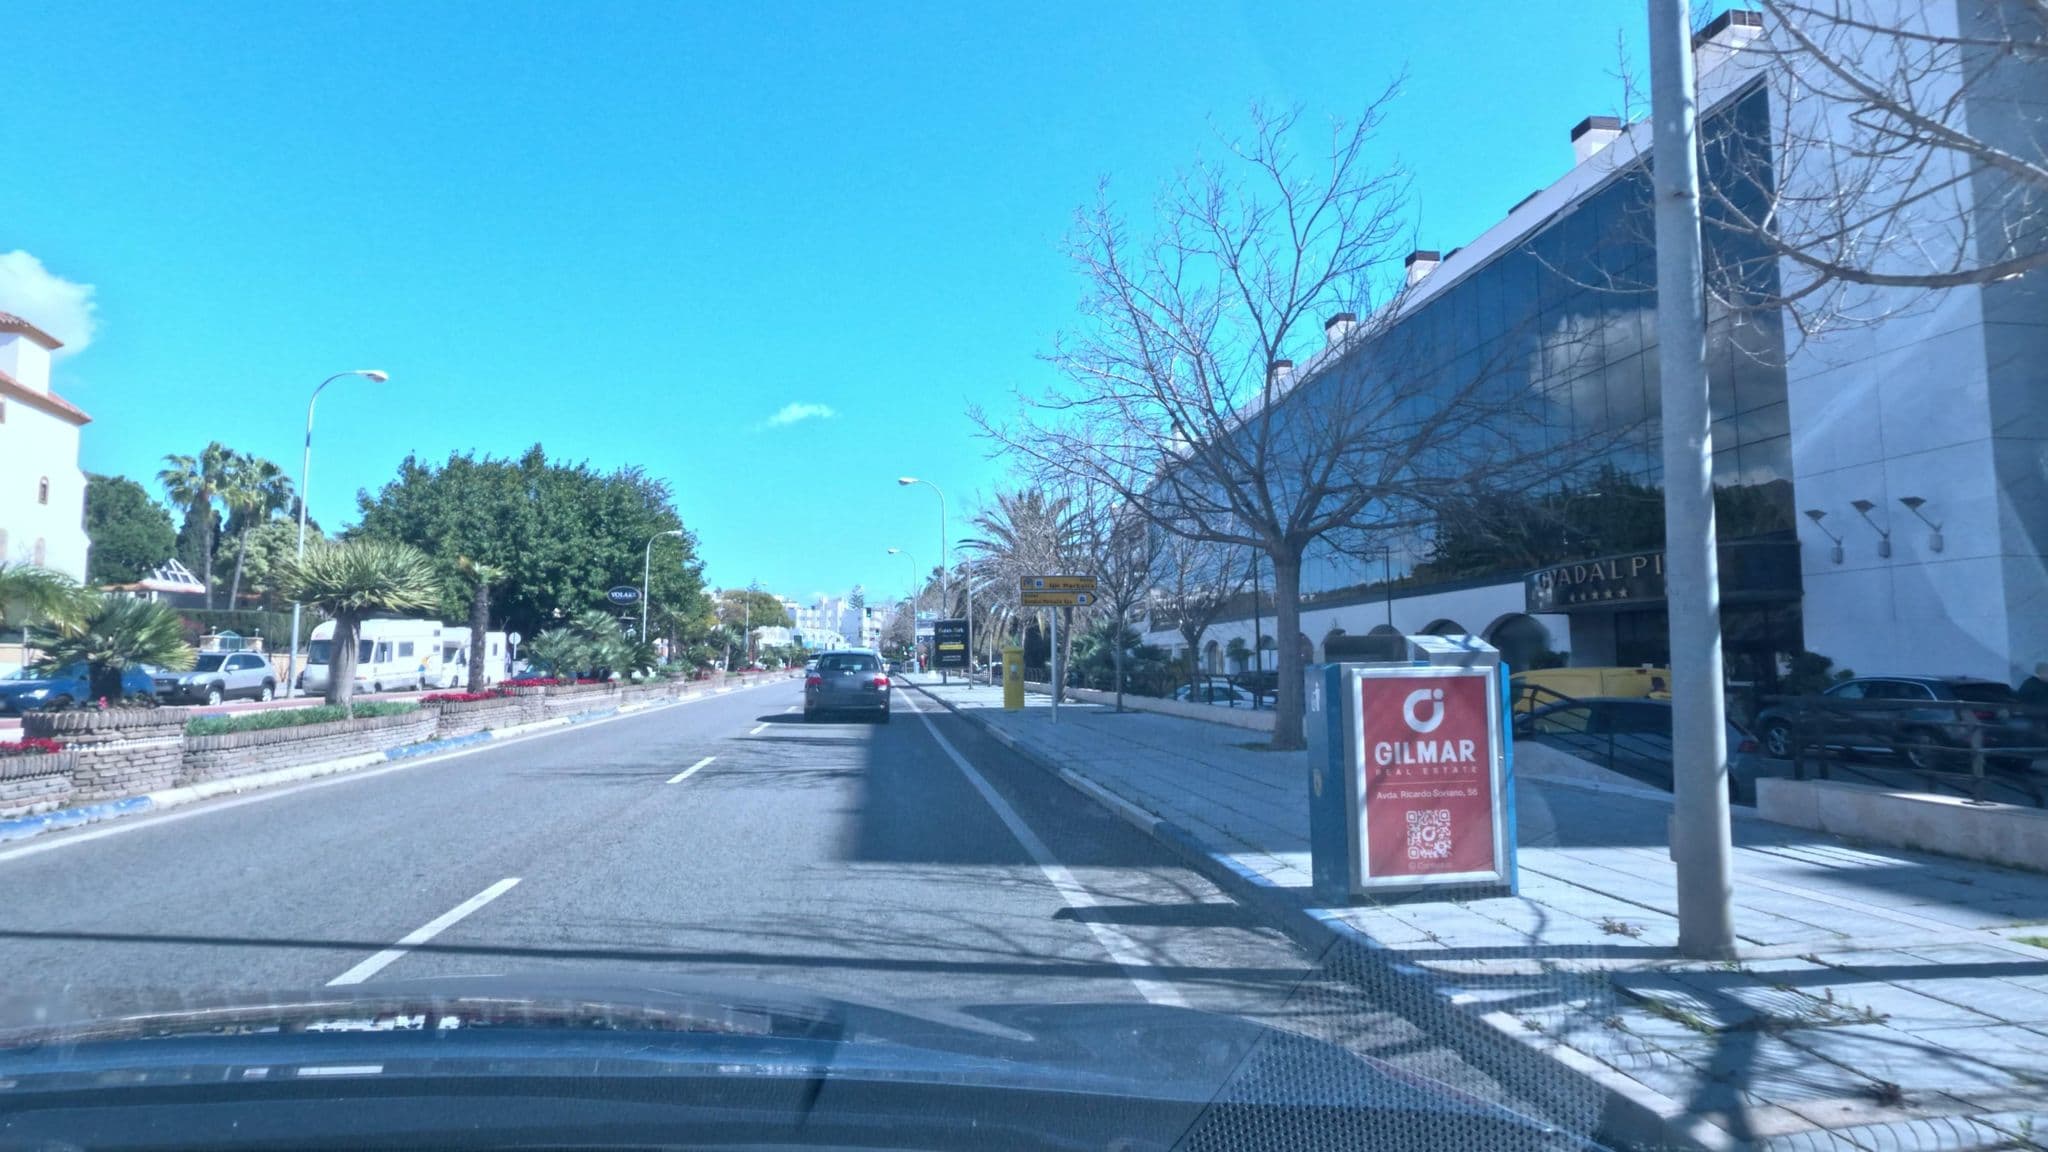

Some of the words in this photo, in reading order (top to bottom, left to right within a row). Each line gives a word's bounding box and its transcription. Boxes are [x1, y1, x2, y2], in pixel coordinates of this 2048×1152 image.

[1375, 739, 1476, 766] GILMAR
[1375, 767, 1412, 776] REAL
[1423, 766, 1477, 775] ESTATE
[1400, 790, 1432, 799] Ricardo
